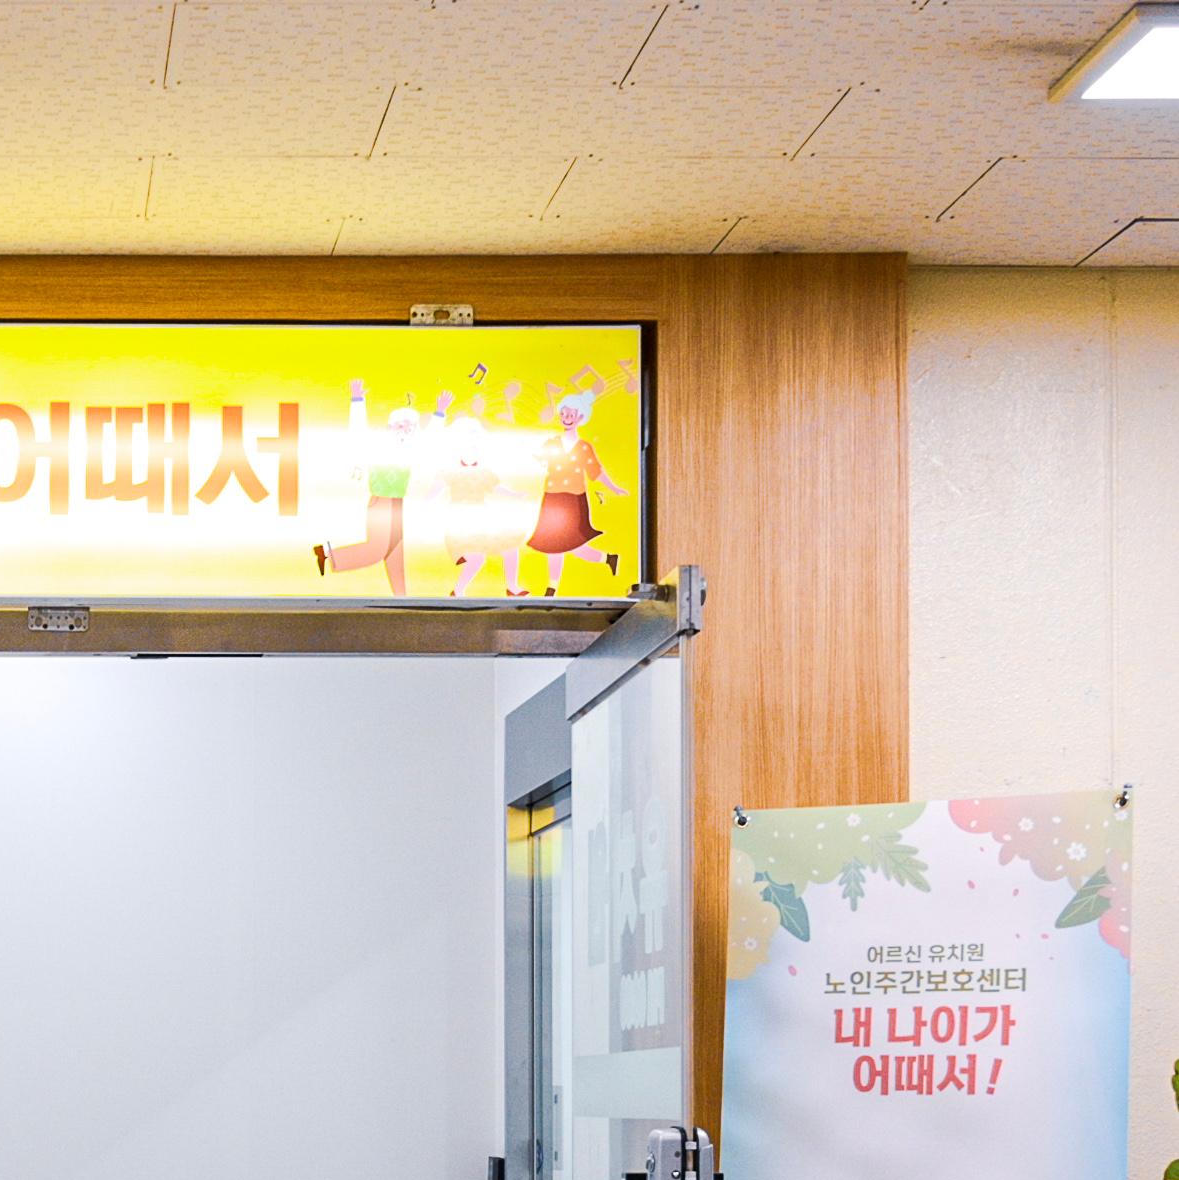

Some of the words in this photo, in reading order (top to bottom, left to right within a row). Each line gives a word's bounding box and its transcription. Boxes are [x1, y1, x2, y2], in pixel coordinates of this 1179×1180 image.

[866, 944, 922, 965] 어르신
[927, 942, 985, 964] 유치원
[823, 967, 1027, 996] 노인주간보호센터
[834, 1006, 873, 1048] 내
[886, 1004, 1017, 1048] 나이가
